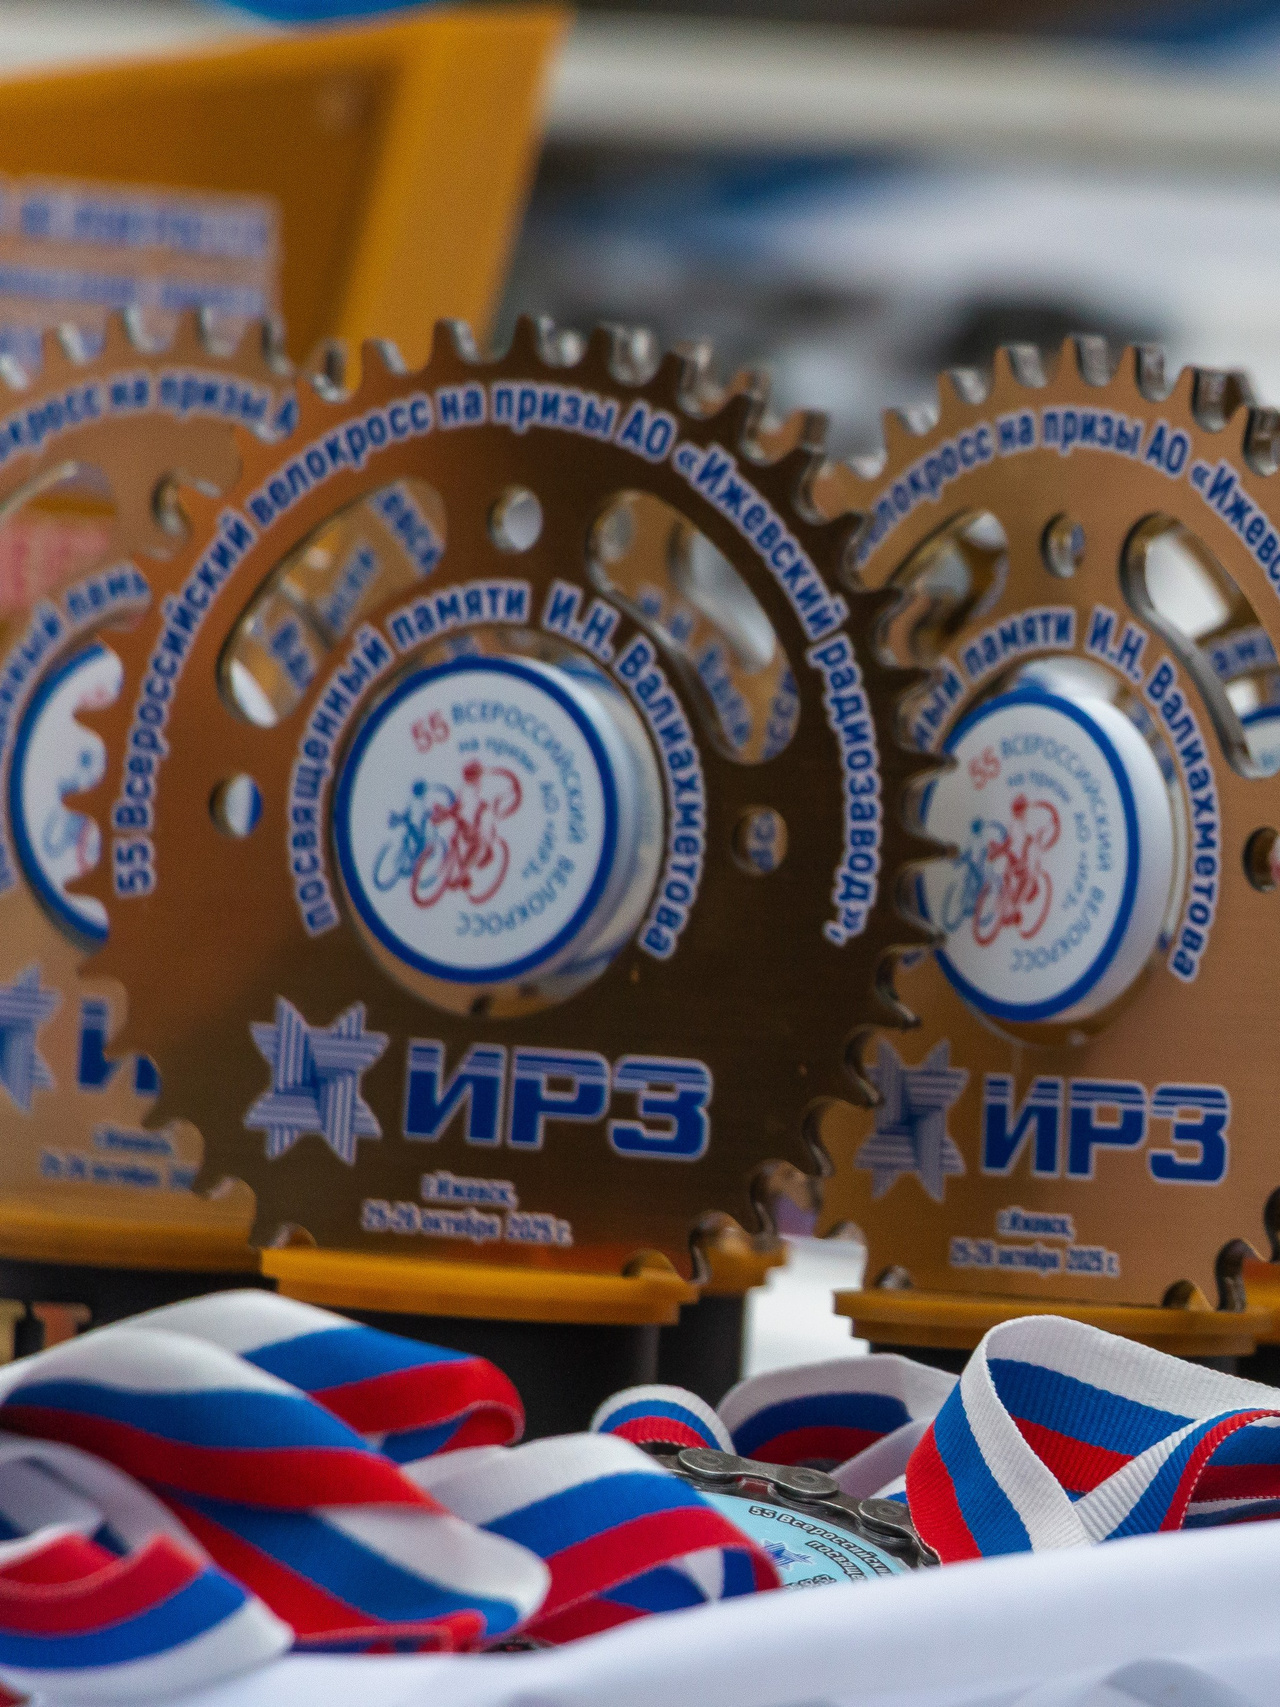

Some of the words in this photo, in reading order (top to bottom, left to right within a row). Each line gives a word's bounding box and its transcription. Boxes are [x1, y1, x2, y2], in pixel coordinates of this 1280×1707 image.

[249, 396, 430, 527] велокросс
[439, 387, 484, 426] на
[495, 386, 614, 442] призы
[622, 409, 675, 458] АО
[999, 414, 1034, 450] на
[1043, 410, 1142, 454] призы
[1146, 423, 1190, 475] АО
[676, 446, 846, 639] «Ижевский
[114, 512, 253, 831] Всероссийский
[291, 631, 390, 932] посвященный
[391, 586, 527, 647] памяти
[545, 585, 616, 657] И.Н.
[617, 642, 701, 952] Валиахметова
[410, 708, 450, 753] 55
[814, 639, 878, 939] радиозавод»,
[962, 610, 1074, 677] памяти
[1089, 608, 1142, 680] И.Н.
[1147, 662, 1218, 977] Валиахметова
[115, 839, 153, 893] 55
[404, 1042, 712, 1159] ИРЗ
[982, 1074, 1231, 1185] ИРЗ
